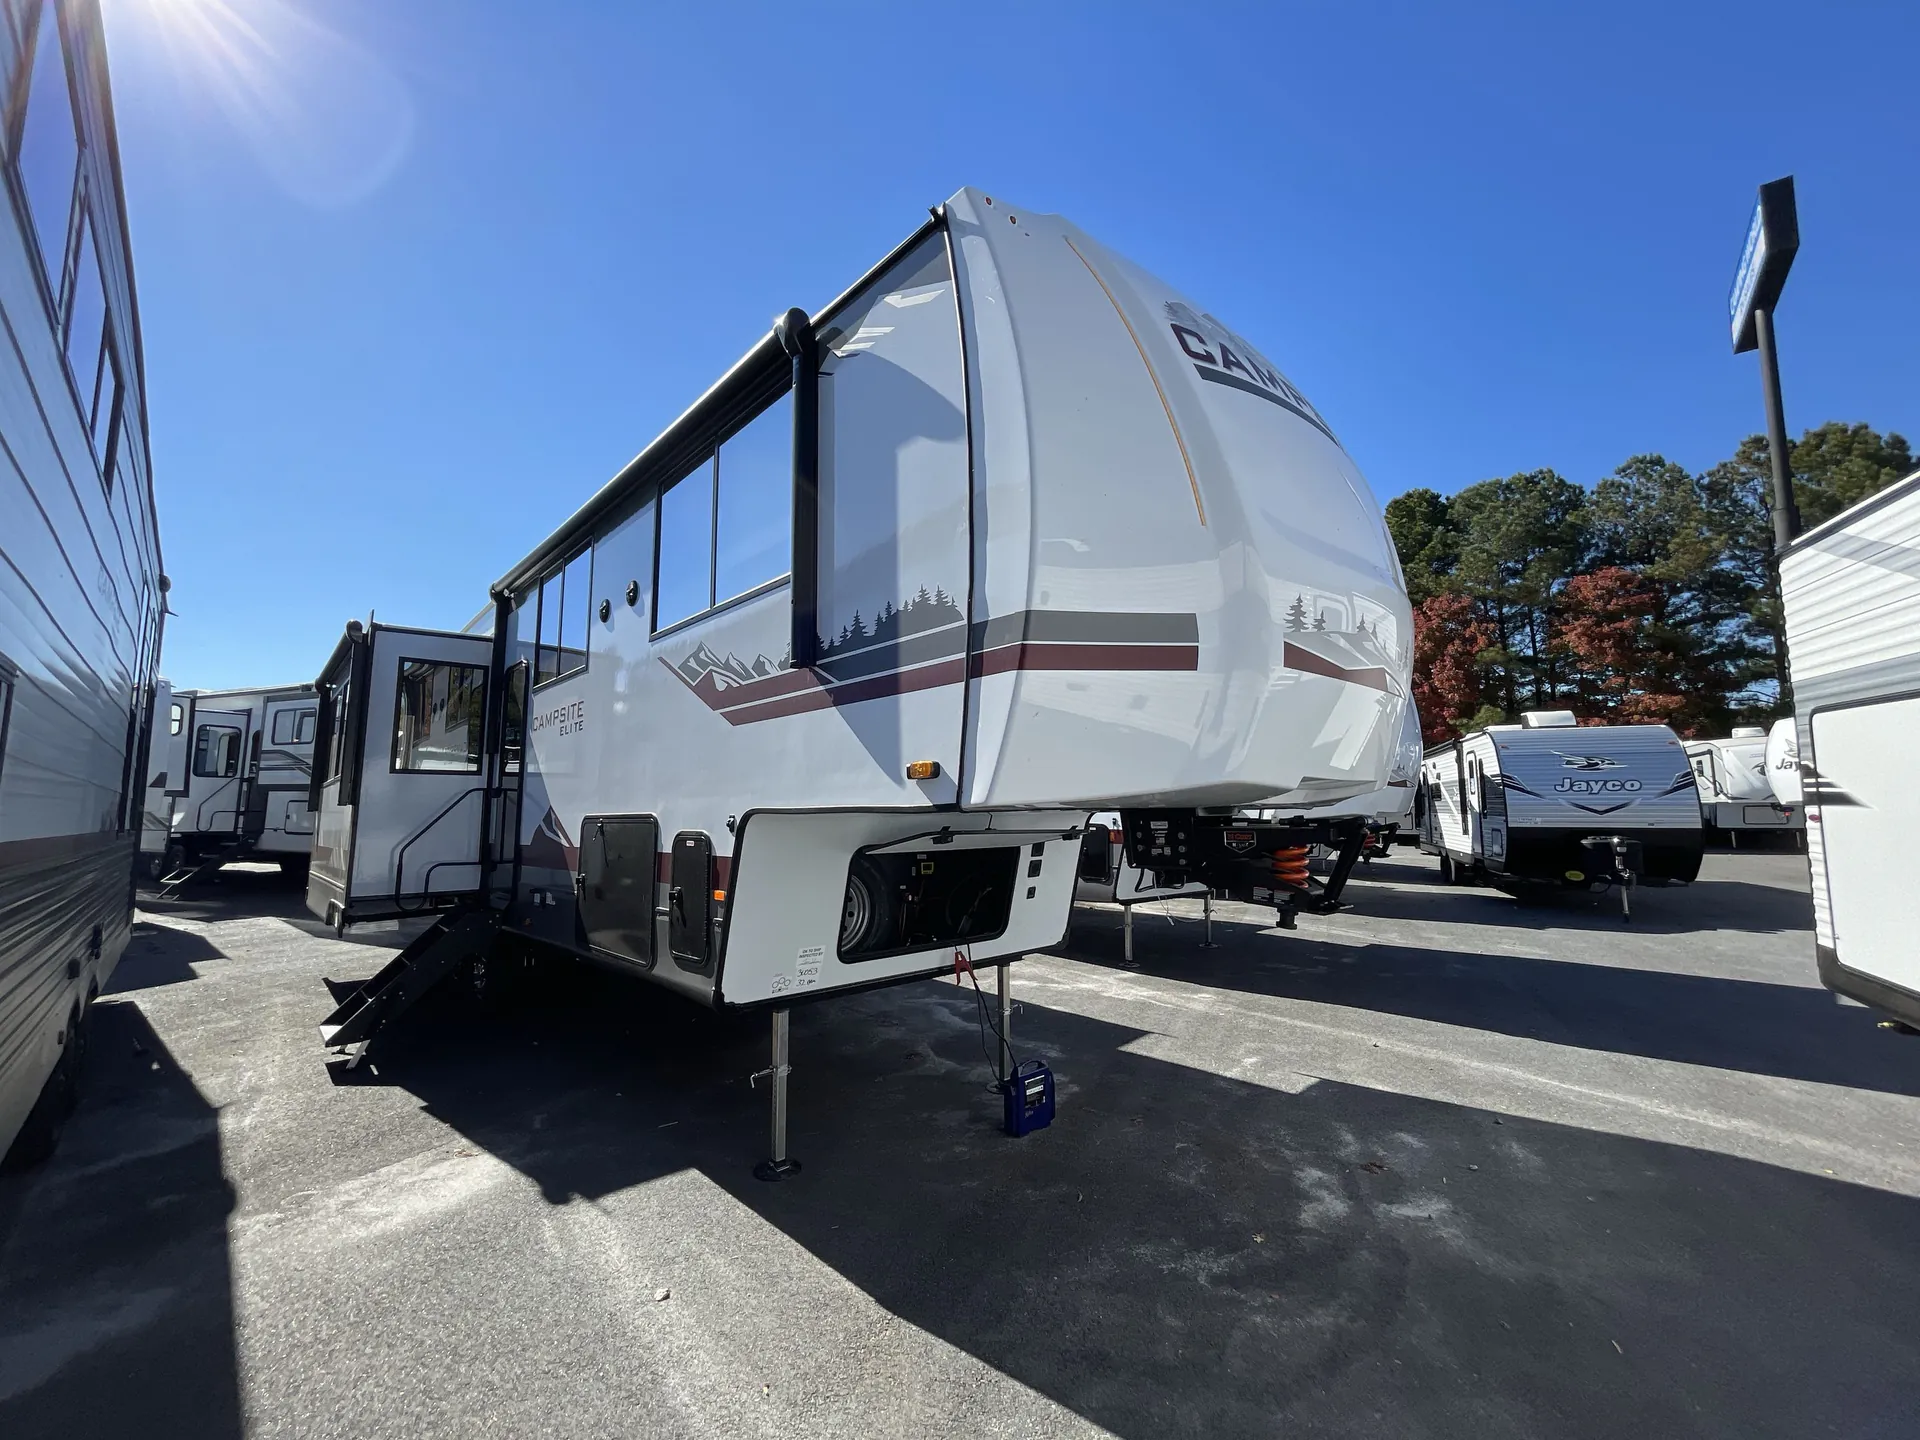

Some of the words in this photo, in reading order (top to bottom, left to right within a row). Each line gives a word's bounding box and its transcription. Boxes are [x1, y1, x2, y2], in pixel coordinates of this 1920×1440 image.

[532, 701, 585, 731] CAMPSITE
[560, 720, 584, 736] ELITE
[1775, 758, 1800, 772] Jay
[1554, 777, 1642, 794] Jayco
